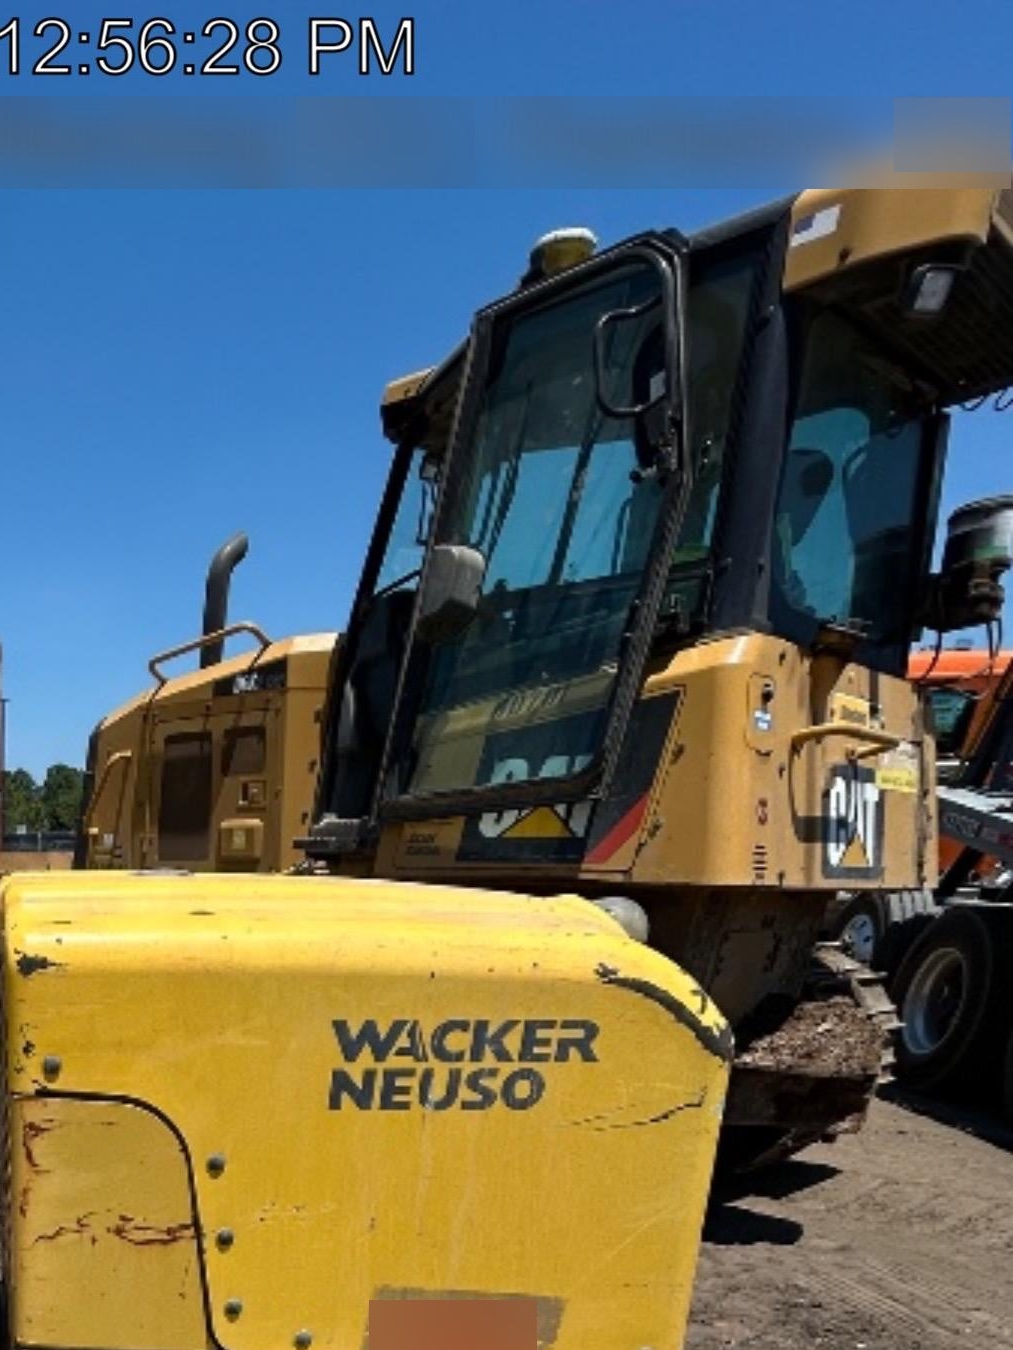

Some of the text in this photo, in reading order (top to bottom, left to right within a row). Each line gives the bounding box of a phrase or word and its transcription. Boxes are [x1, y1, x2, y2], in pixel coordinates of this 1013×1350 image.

[827, 776, 879, 867] CAT
[331, 1019, 601, 1063] WACKER
[328, 1067, 546, 1111] NEUSO
